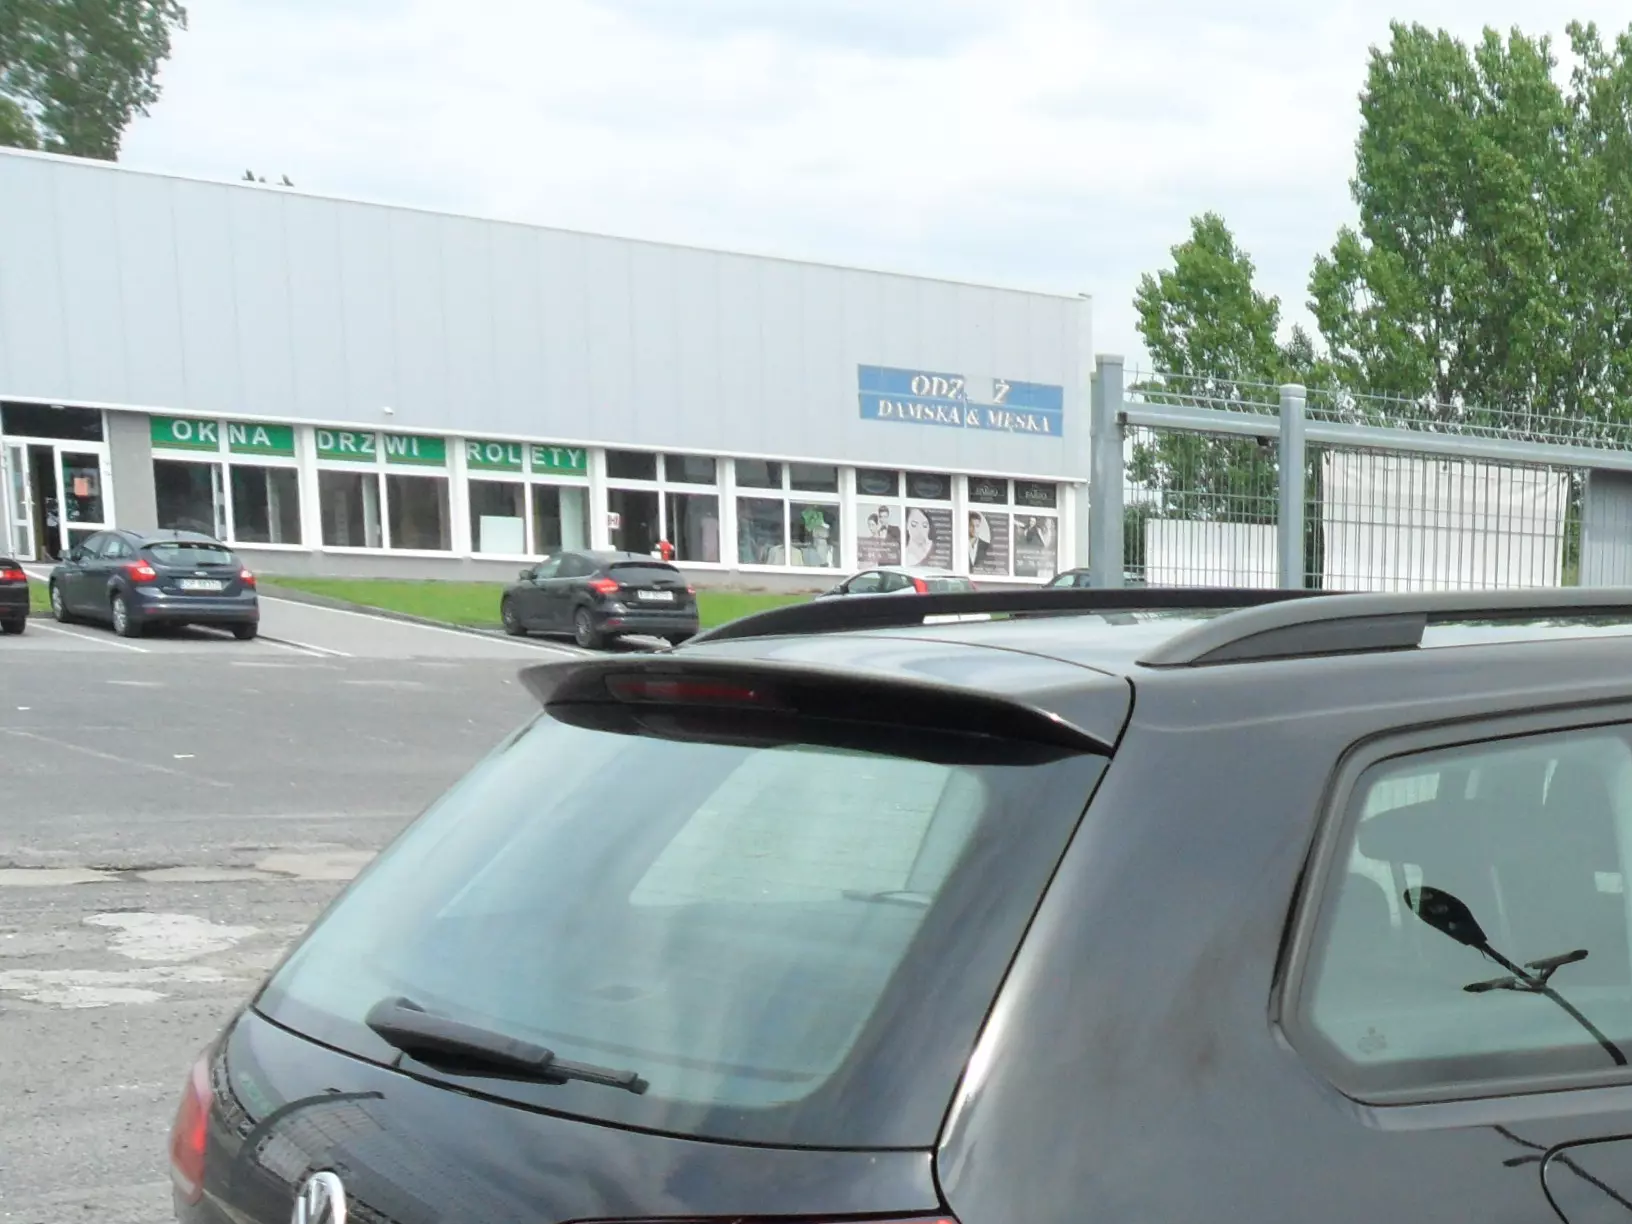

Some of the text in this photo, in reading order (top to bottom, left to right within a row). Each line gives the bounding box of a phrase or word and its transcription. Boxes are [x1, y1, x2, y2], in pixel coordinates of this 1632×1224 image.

[878, 399, 960, 425] DAMSKA
[172, 419, 271, 446] OKNA
[317, 430, 420, 456] DRZWI
[467, 442, 582, 468] ROLETY
